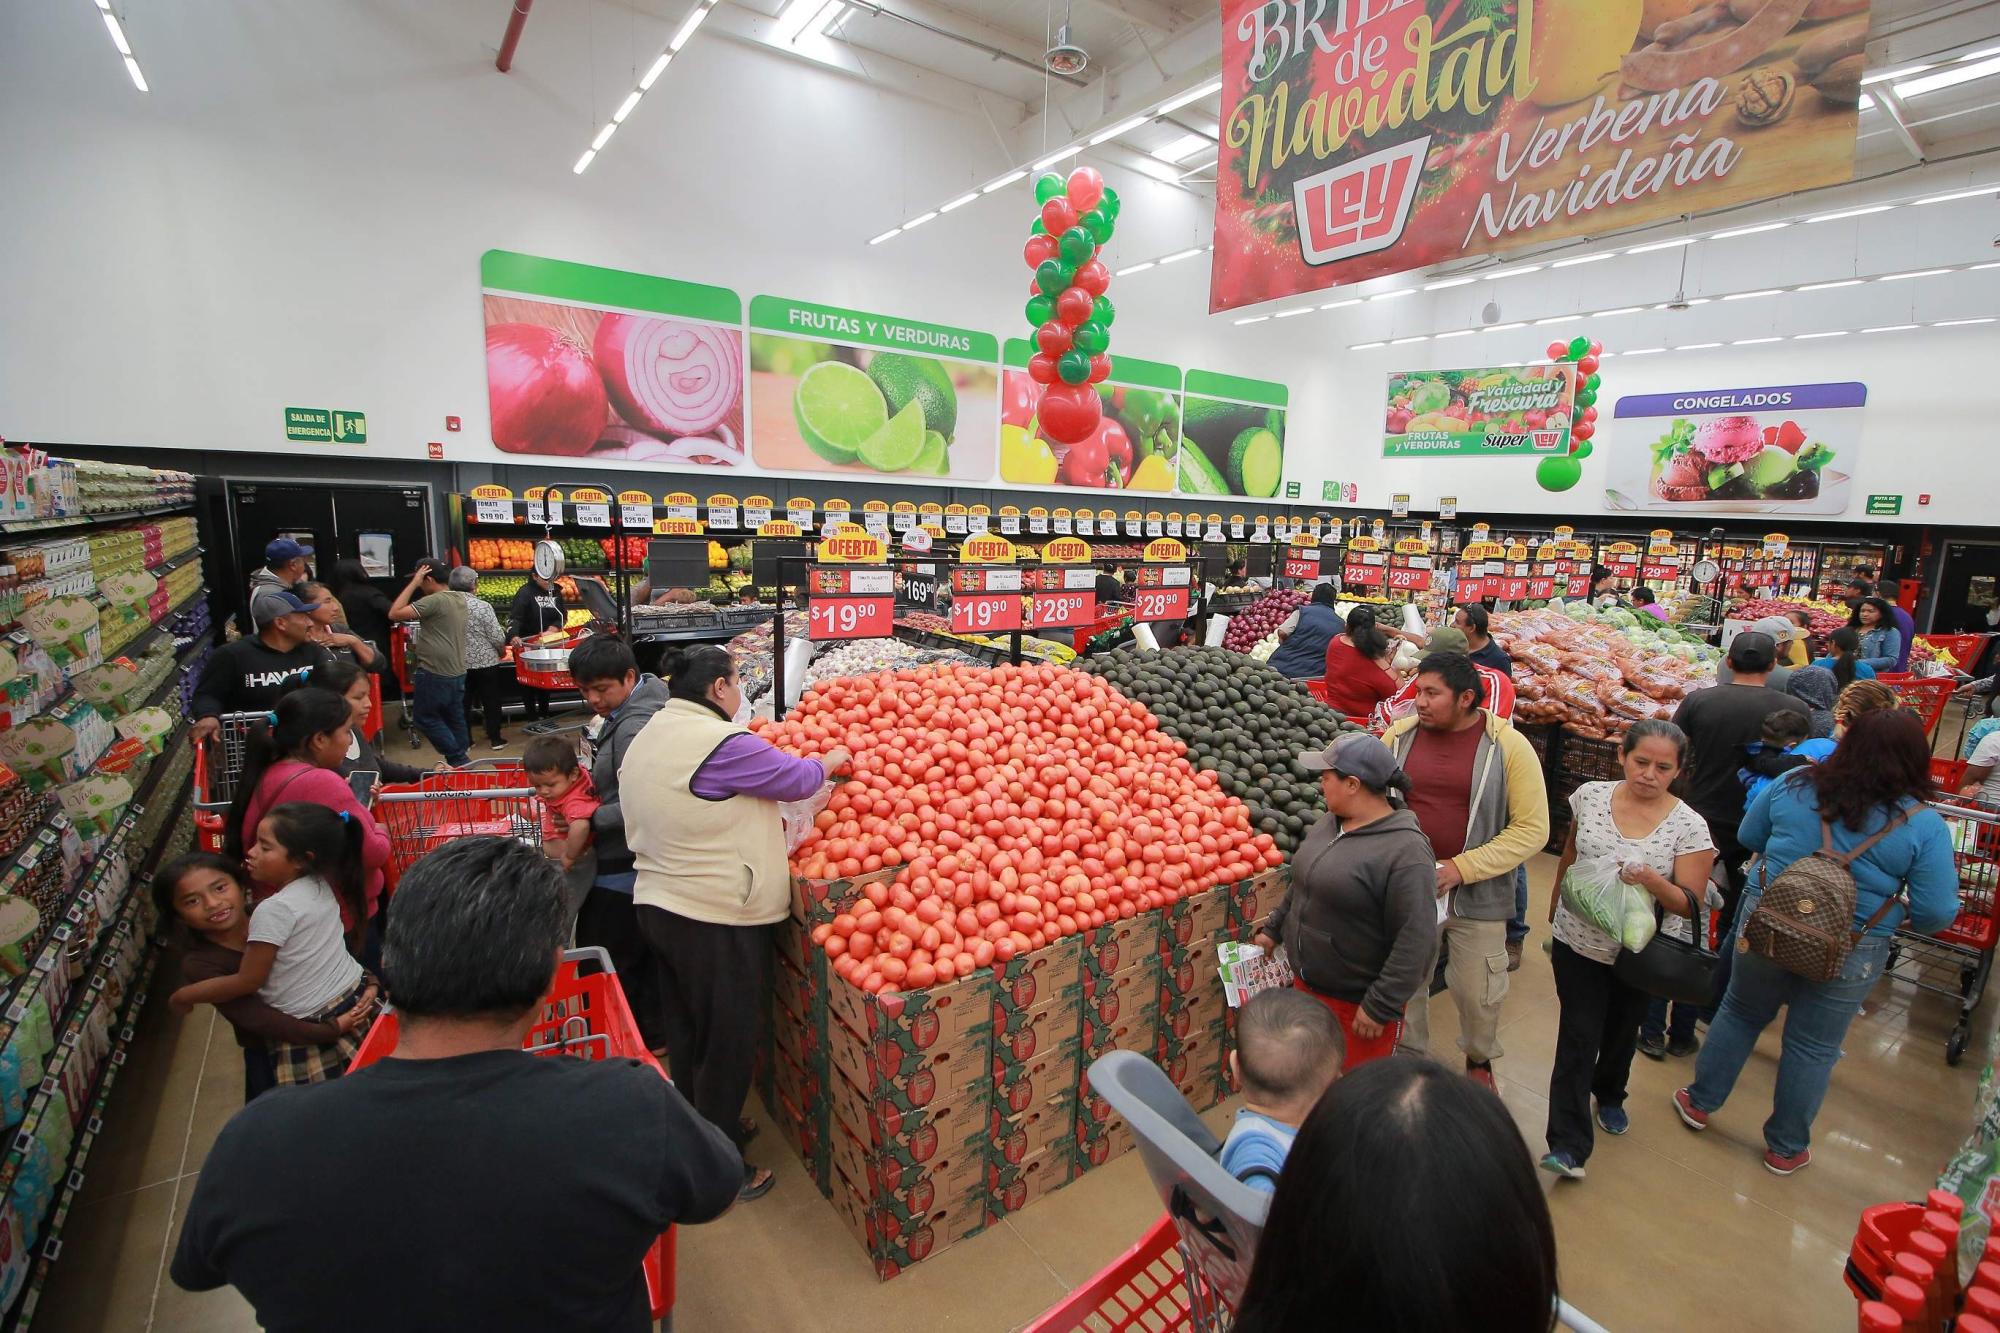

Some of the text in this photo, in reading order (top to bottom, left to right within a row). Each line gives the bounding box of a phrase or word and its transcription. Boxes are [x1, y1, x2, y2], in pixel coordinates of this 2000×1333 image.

[1334, 30, 1388, 86] de
[1226, 0, 1539, 189] Navidad
[1497, 76, 1729, 182] Verbena
[1461, 131, 1743, 249] Navideña
[788, 308, 970, 352] FRUTAS Y VERDURAS
[1487, 380, 1565, 397] Variedad y
[1467, 392, 1559, 415] Frescura
[1672, 391, 1792, 411] CONGELADOS
[290, 413, 315, 422] SALIDA
[287, 427, 331, 437] EMERGENCIA
[1407, 431, 1449, 440] FRUTAS
[1481, 433, 1528, 449] Super
[1395, 440, 1461, 452] y VERDURAS
[477, 489, 507, 497] OFERTA
[529, 490, 557, 498] OFETA
[576, 493, 602, 501] OFERTA
[622, 494, 647, 502] OFERTA
[669, 496, 692, 504] OFERTA
[711, 497, 734, 505] OFERTA
[660, 522, 696, 533] OFERTA
[764, 524, 796, 535] OFERTA
[1295, 536, 1314, 544] OFERTA
[1353, 540, 1374, 548] OFERTA
[1400, 541, 1423, 550] OFERTA
[828, 539, 878, 556] OFERTA
[969, 541, 1008, 557] OFERTA
[1049, 543, 1084, 557] OFERTA
[1151, 544, 1180, 557] OFERTA
[1466, 547, 1485, 556] OFERTA
[1510, 547, 1526, 556] OFERTA
